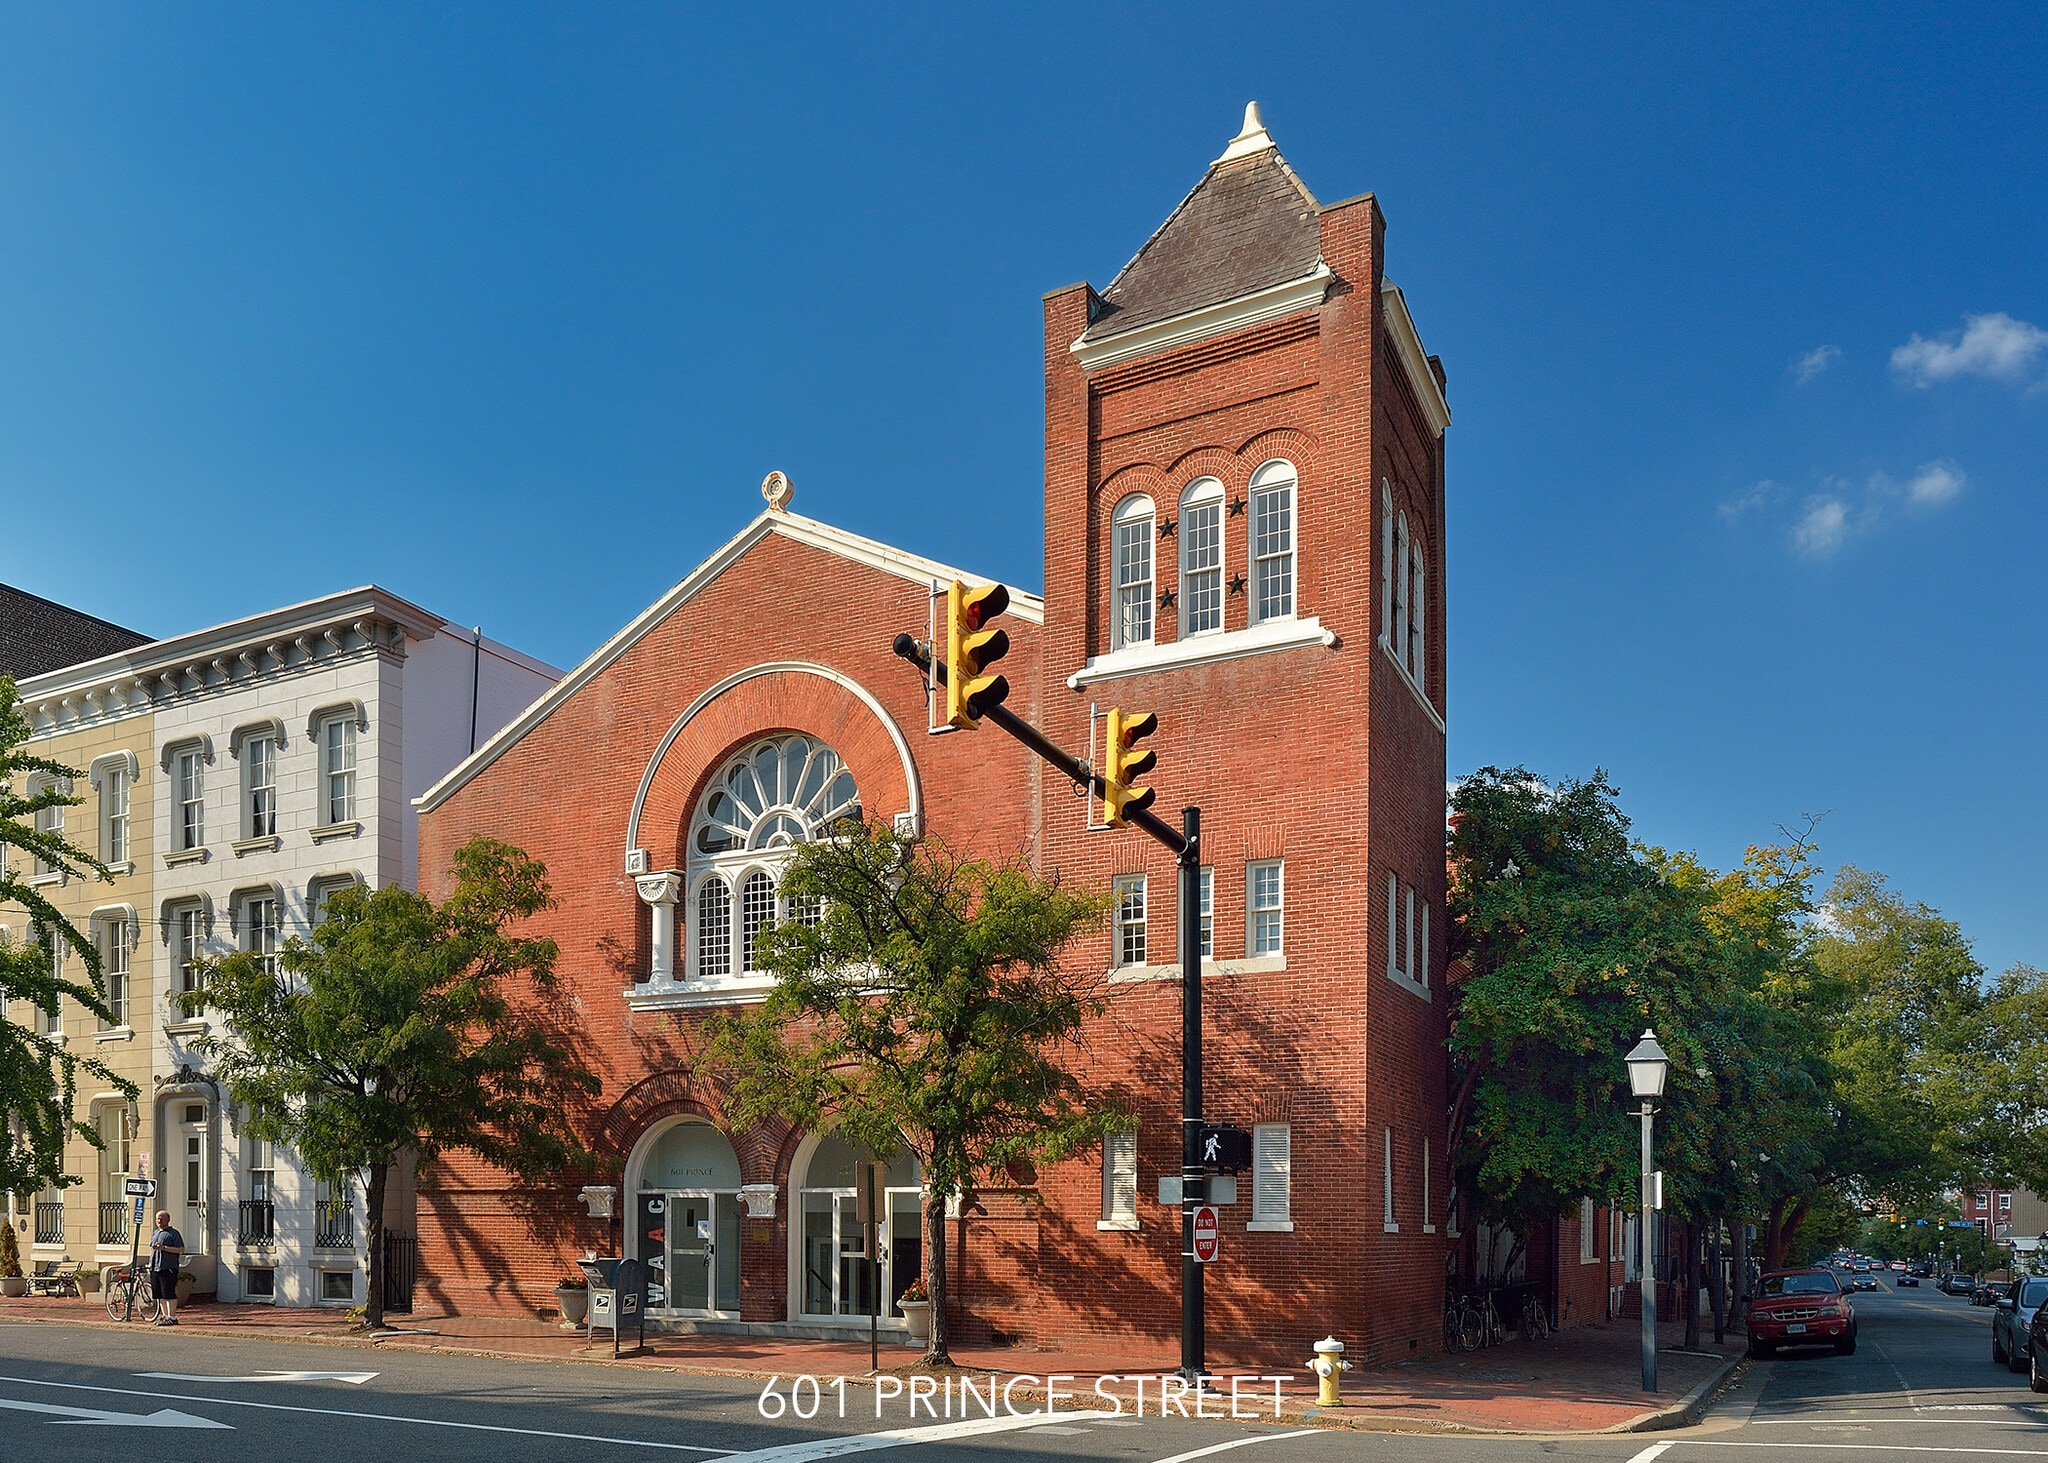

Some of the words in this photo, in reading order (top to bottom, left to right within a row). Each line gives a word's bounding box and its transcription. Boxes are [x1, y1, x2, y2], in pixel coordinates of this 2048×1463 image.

[686, 1167, 713, 1176] PRINCE
[1198, 1218, 1204, 1227] DO
[1205, 1218, 1214, 1227] NOT
[1199, 1241, 1212, 1250] ENTER
